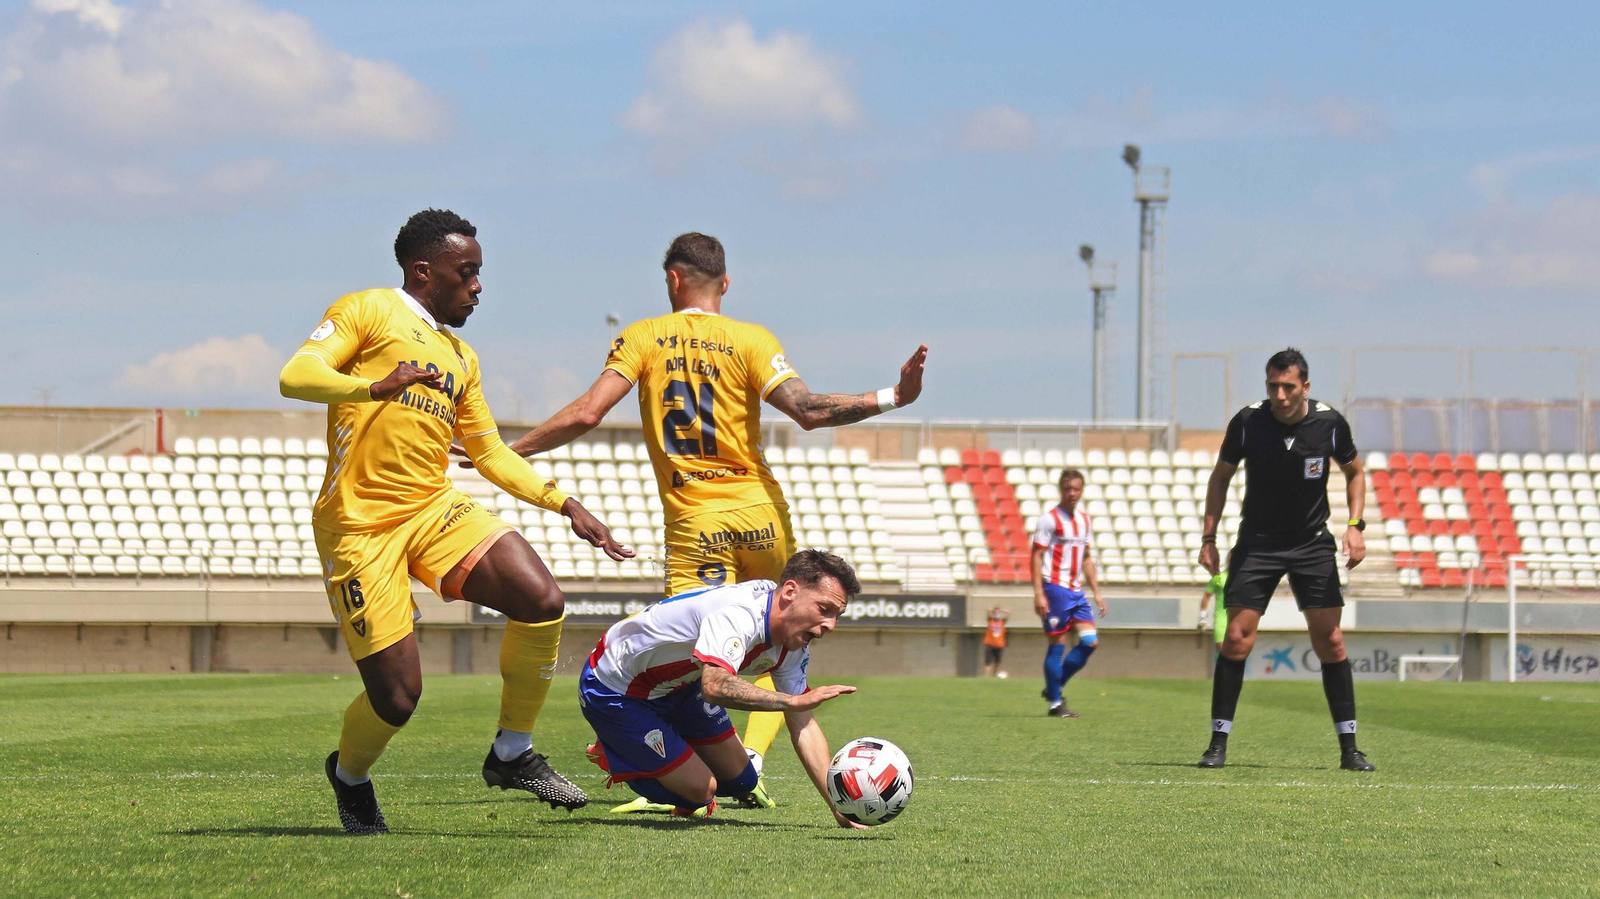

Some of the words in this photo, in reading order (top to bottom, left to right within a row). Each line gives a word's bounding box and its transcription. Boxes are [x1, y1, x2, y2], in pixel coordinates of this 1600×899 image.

[662, 379, 719, 460] 21
[747, 543, 775, 552] CAR
[341, 578, 366, 614] 16
